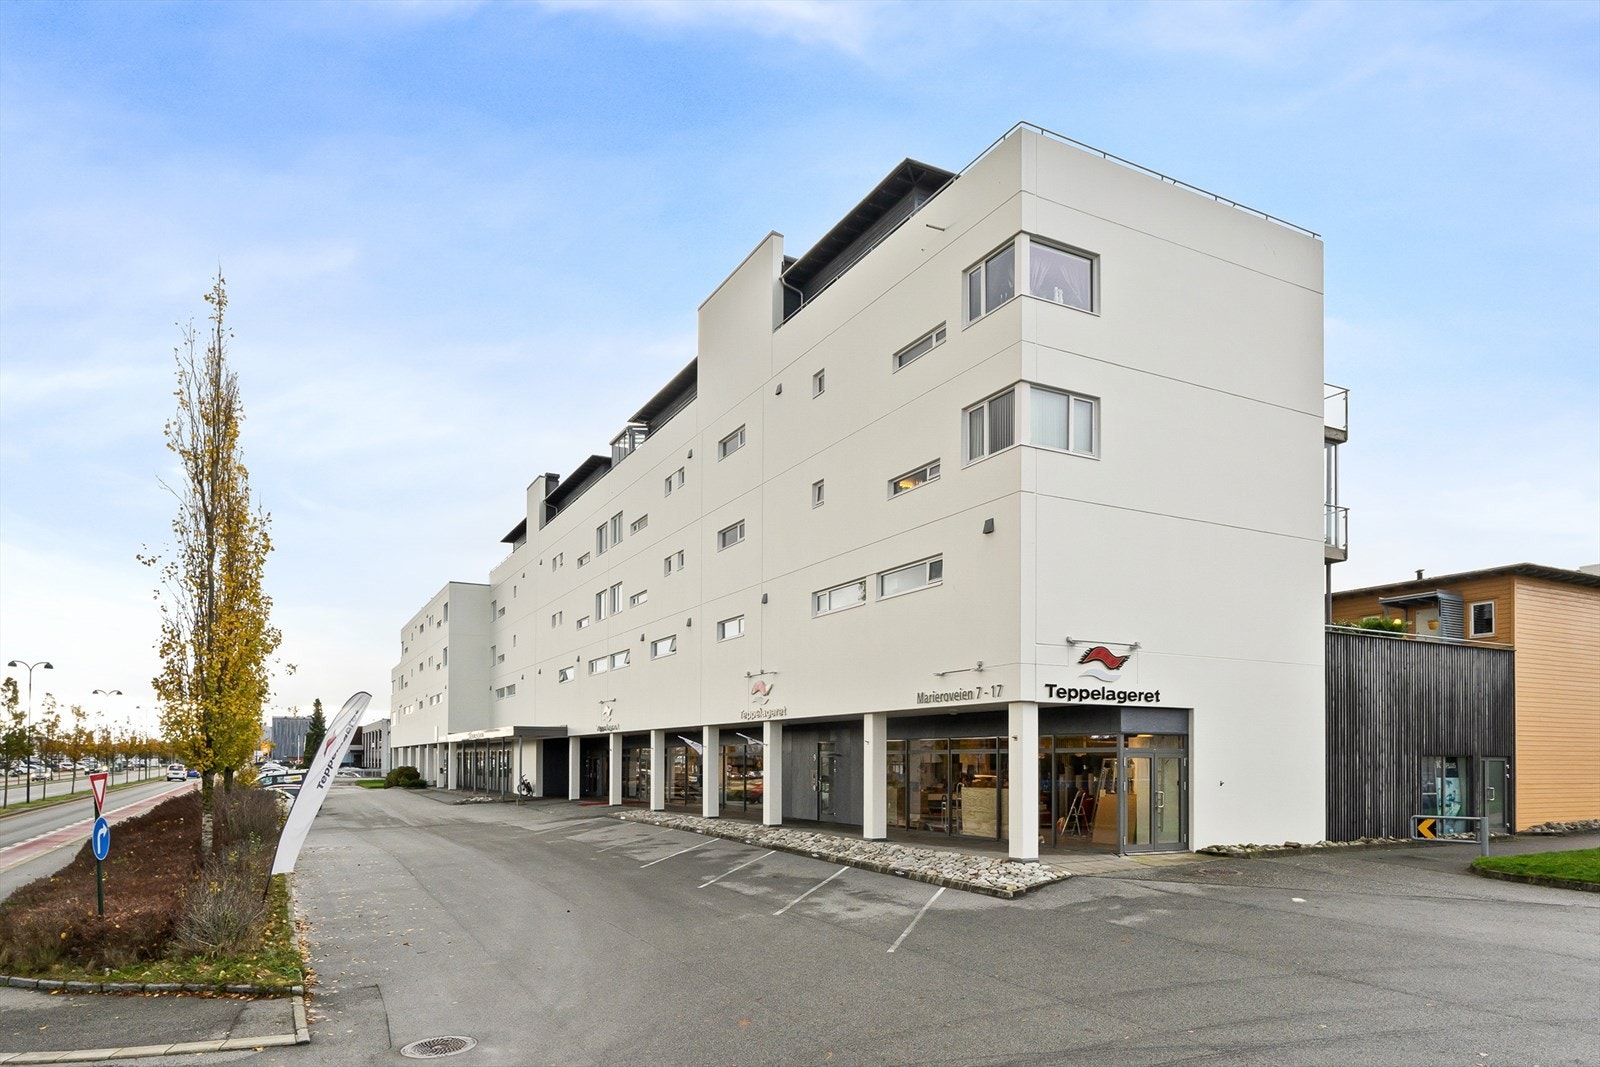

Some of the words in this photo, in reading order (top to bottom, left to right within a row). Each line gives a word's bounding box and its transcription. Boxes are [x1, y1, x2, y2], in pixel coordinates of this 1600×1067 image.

[916, 687, 974, 704] Marieroveien
[975, 686, 983, 700] 7
[990, 683, 1004, 699] 17
[1044, 683, 1161, 704] Teppelageret
